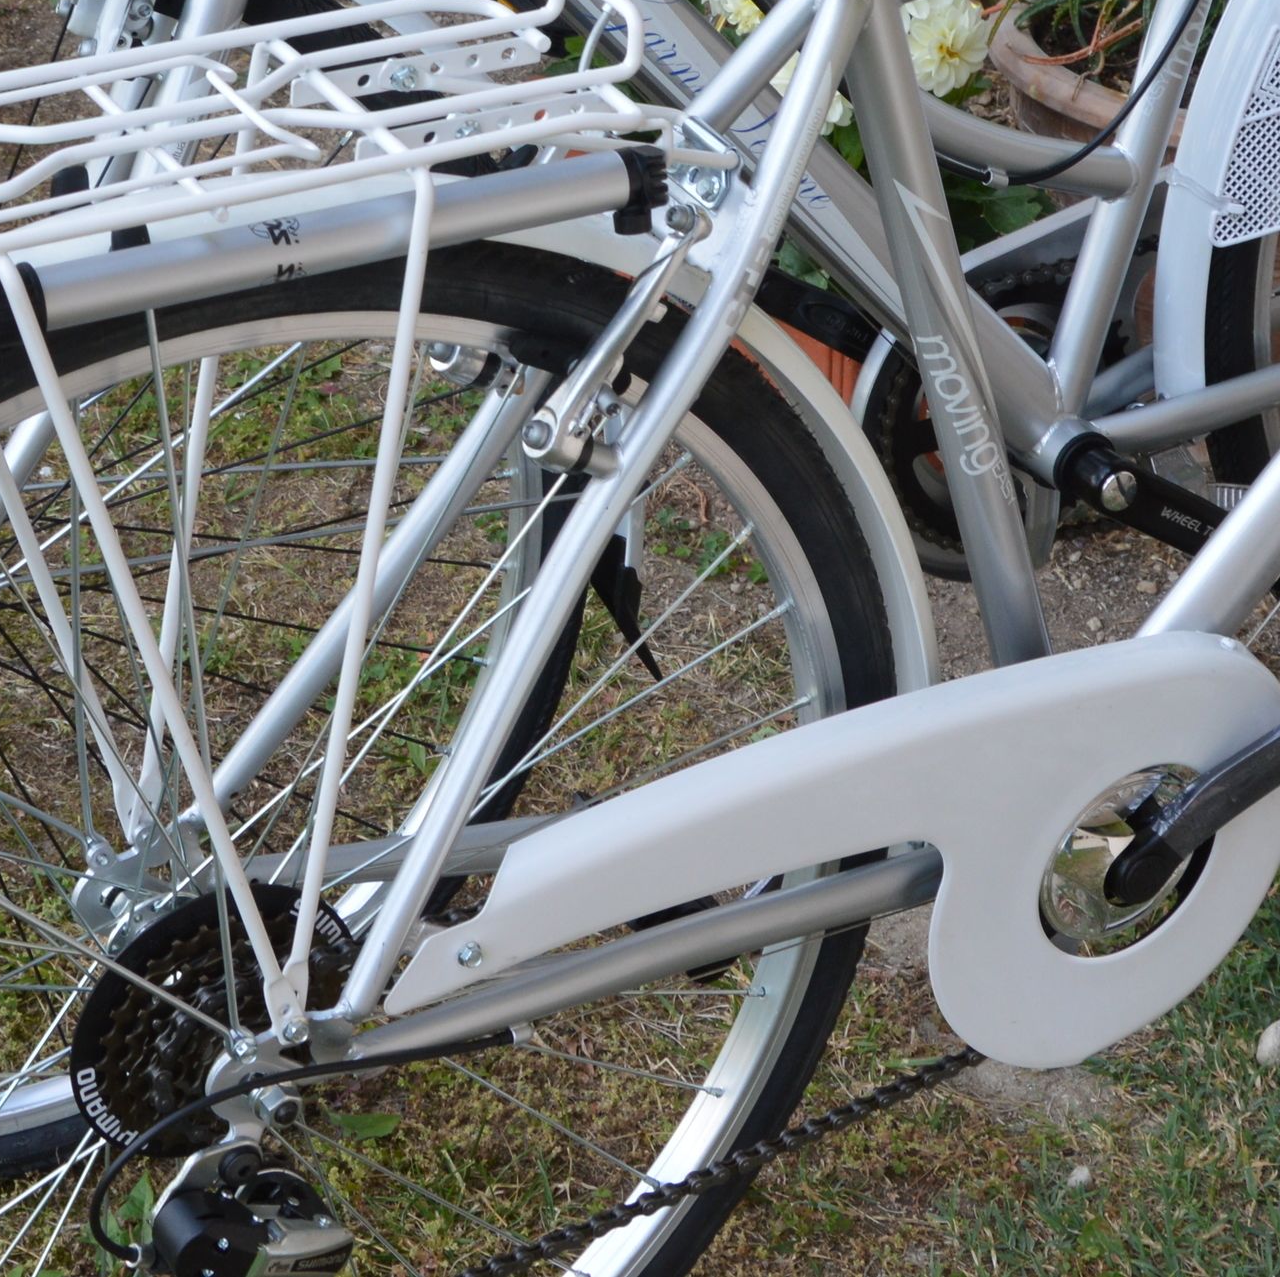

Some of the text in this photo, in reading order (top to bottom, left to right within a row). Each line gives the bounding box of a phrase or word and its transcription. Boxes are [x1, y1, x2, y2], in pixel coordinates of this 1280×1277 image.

[916, 334, 1018, 506] moving EASY
[1161, 506, 1202, 533] WHEEL
